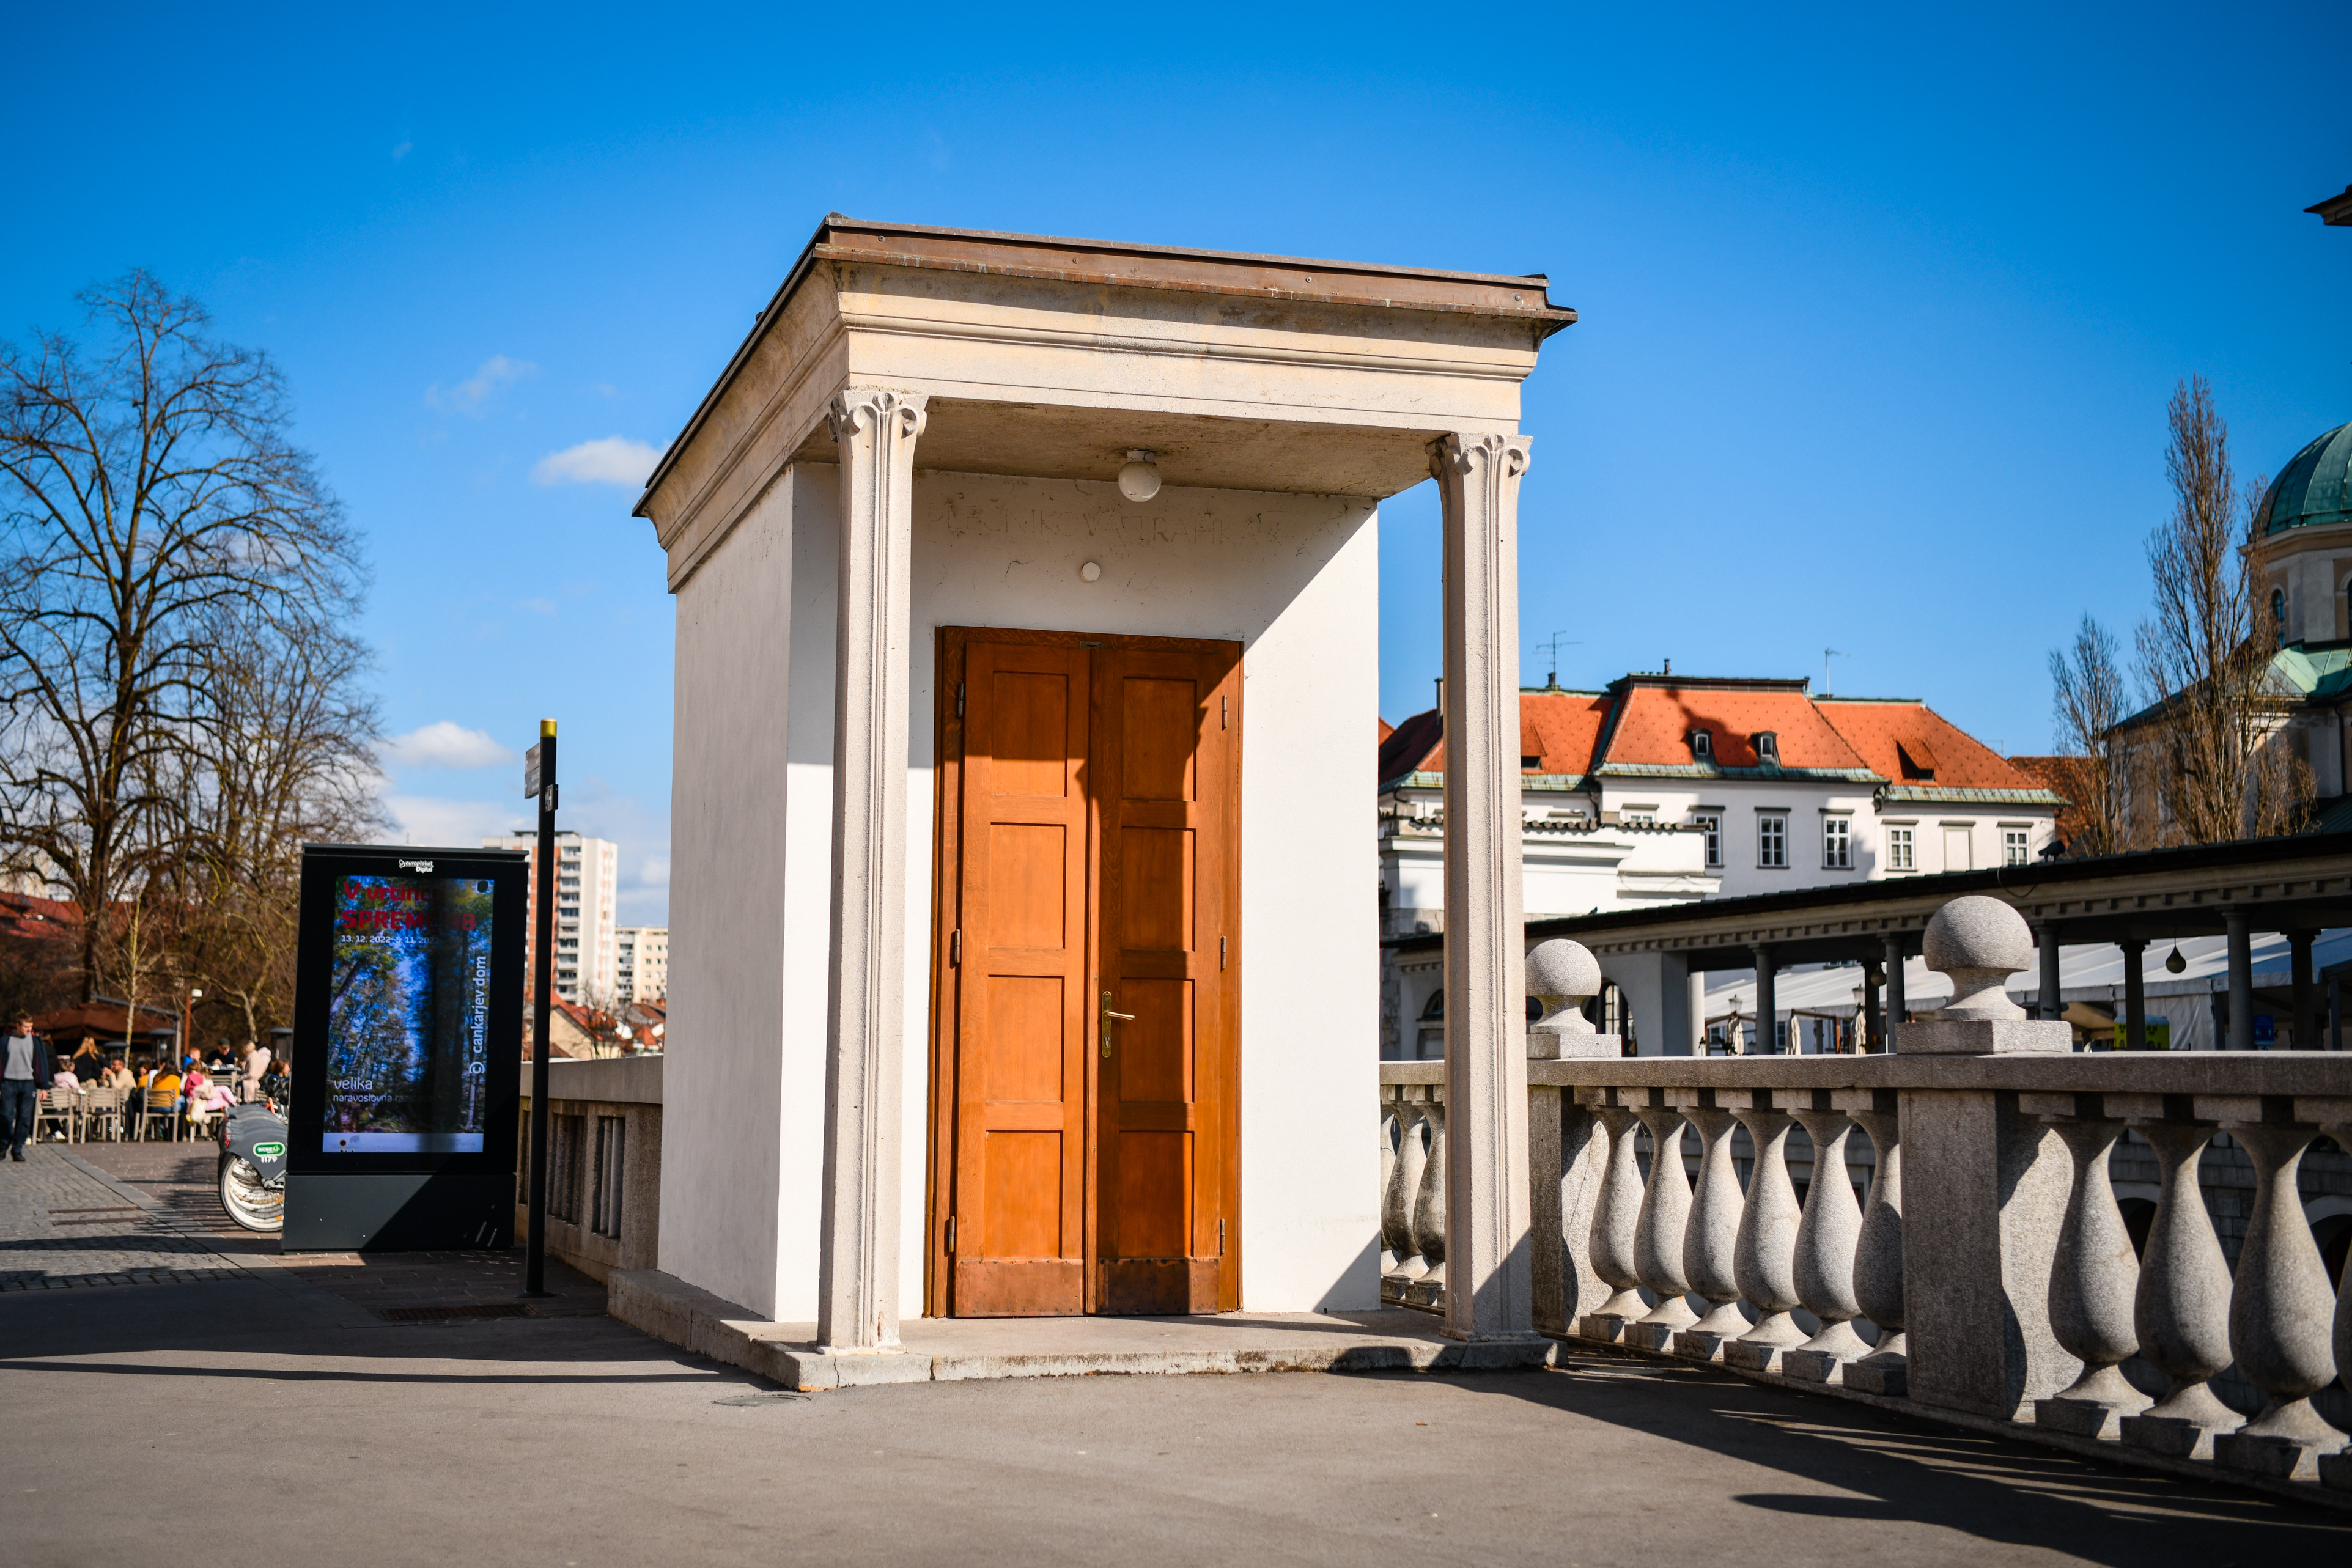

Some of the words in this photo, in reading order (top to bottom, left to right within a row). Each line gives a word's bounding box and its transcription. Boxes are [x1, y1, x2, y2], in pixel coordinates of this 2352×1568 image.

[343, 882, 361, 899] V
[473, 956, 487, 987] dom
[471, 990, 488, 1053] cankarjev
[333, 1077, 373, 1090] velika
[333, 1093, 393, 1102] naravoslovna
